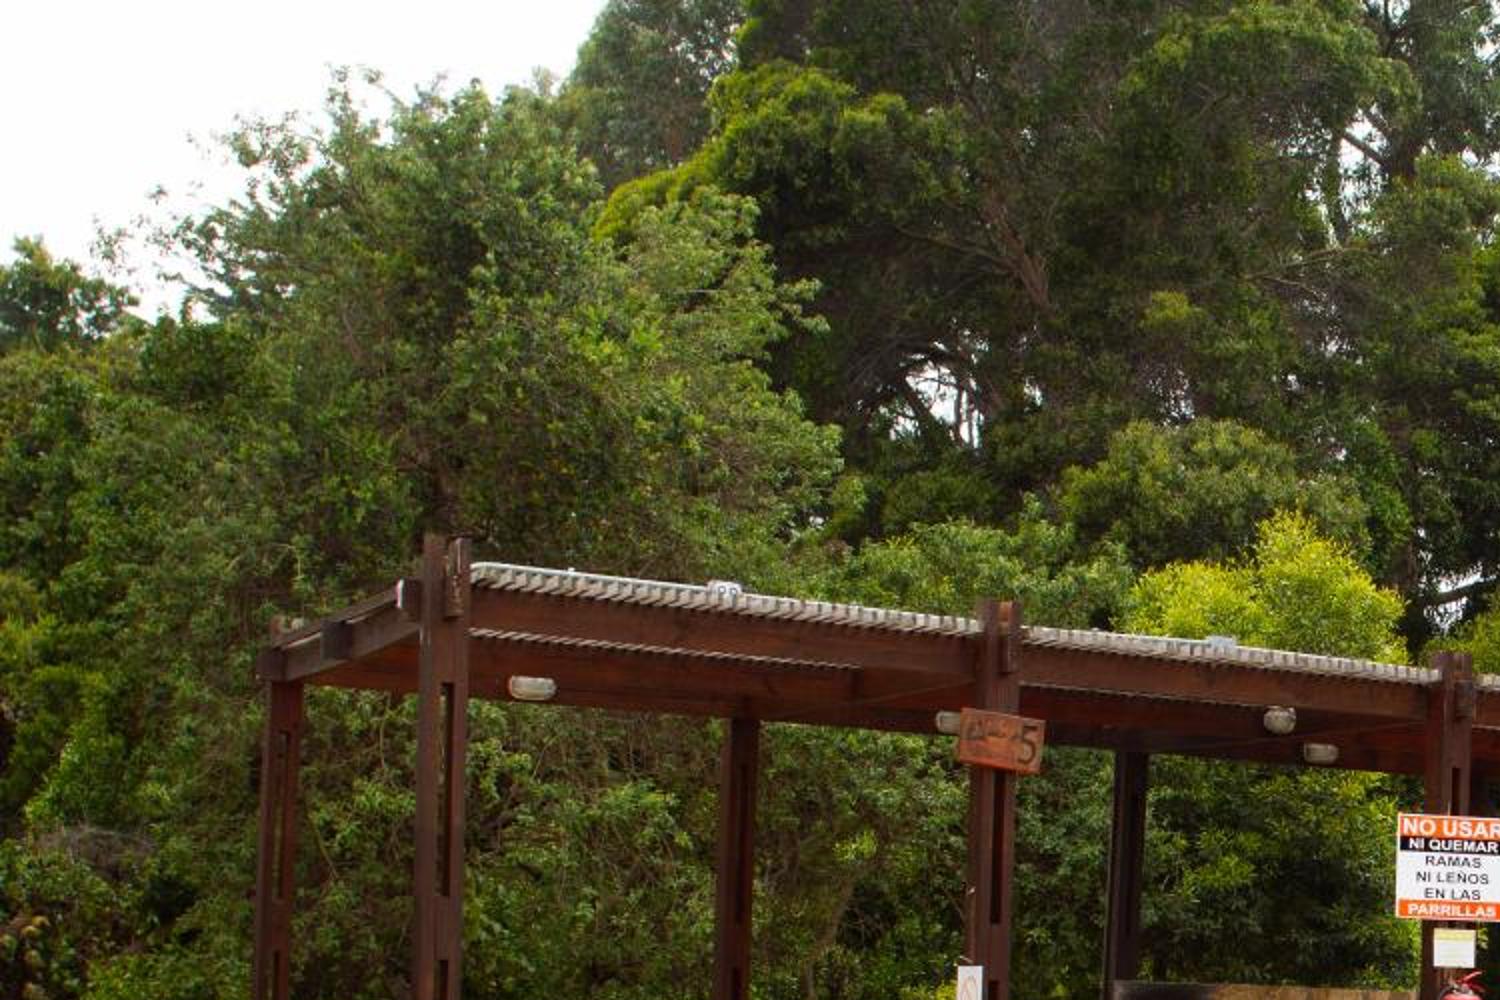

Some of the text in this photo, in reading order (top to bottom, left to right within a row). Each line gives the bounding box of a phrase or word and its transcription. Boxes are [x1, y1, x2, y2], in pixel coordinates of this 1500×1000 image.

[1017, 725, 1038, 765] 5
[1403, 817, 1437, 836] NO
[1409, 838, 1499, 853] NI QUEMAR
[1425, 855, 1482, 868] RAMAS
[1416, 871, 1431, 882] NI
[1425, 887, 1481, 900] EN LAS
[1407, 903, 1496, 917] PARRILLAS
